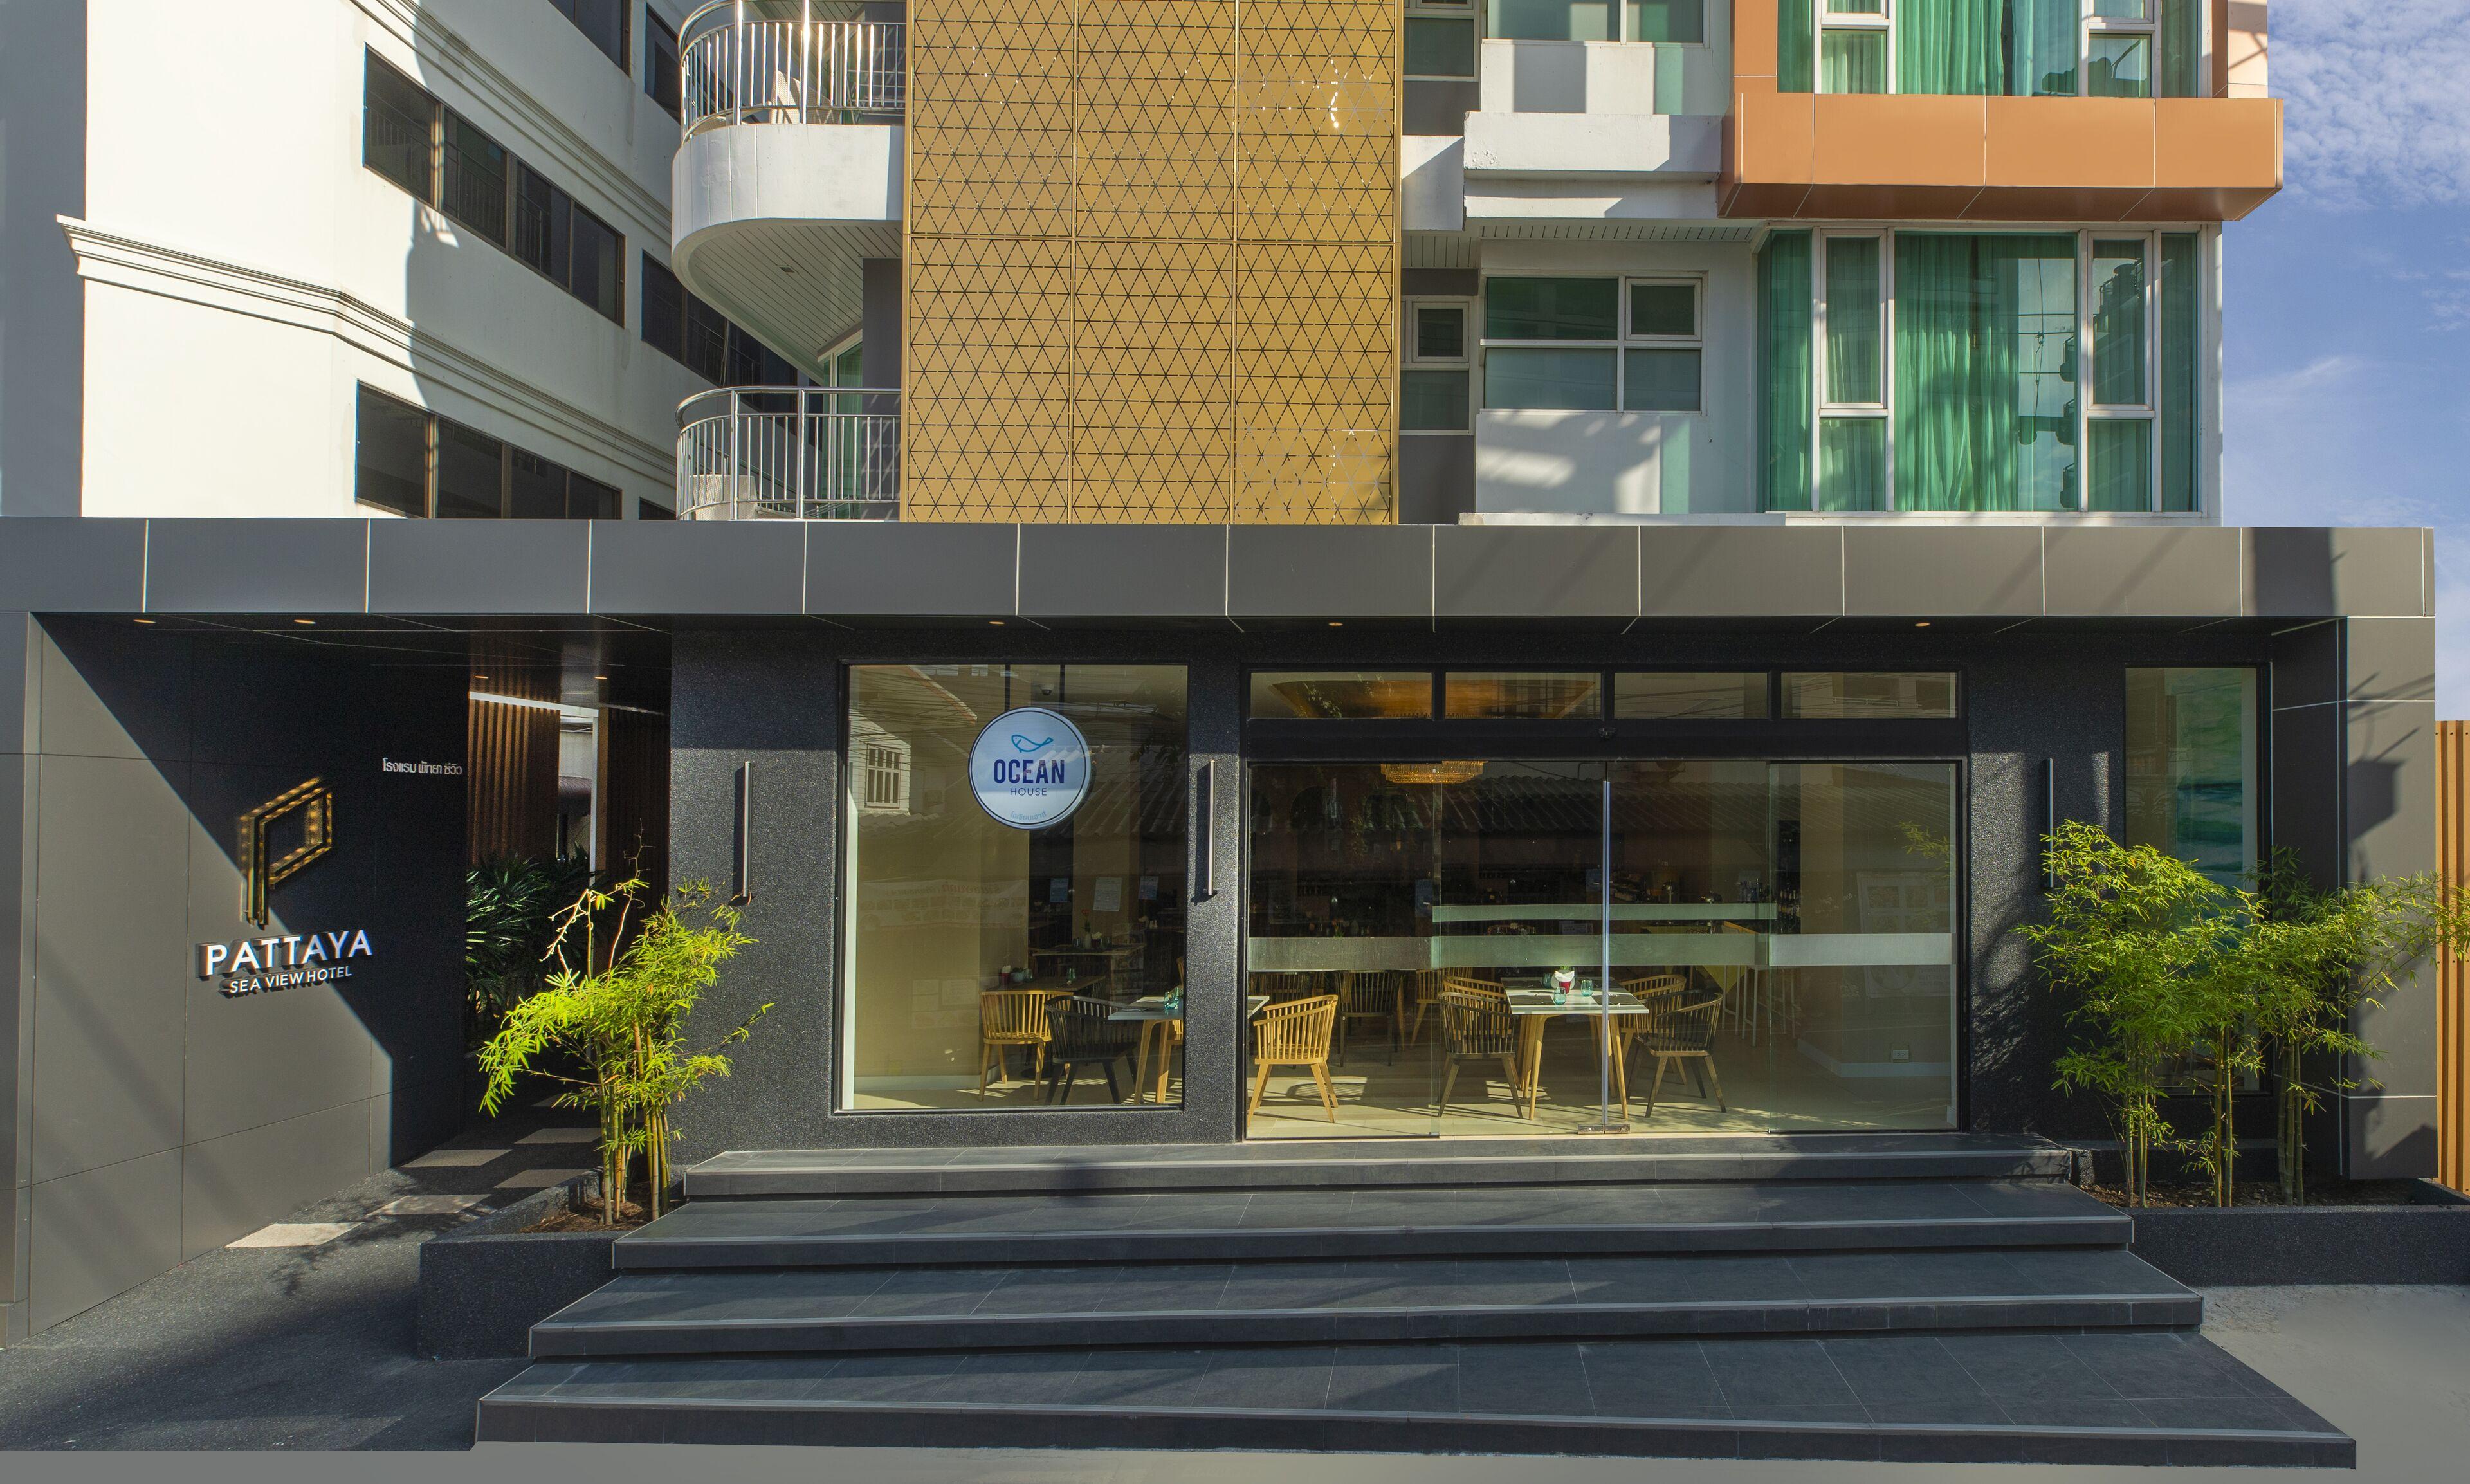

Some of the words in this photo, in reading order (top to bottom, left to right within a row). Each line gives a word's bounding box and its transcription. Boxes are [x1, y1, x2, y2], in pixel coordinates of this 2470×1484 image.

[382, 758, 417, 773] โรงแรม
[419, 760, 443, 774] พัทยา
[994, 759, 1065, 783] OCEAN
[1010, 787, 1047, 796] HOUSE
[205, 929, 373, 976] PATTAYA
[230, 979, 261, 994] SEA
[265, 971, 304, 989] VIEW
[307, 965, 352, 983] HOTEL
